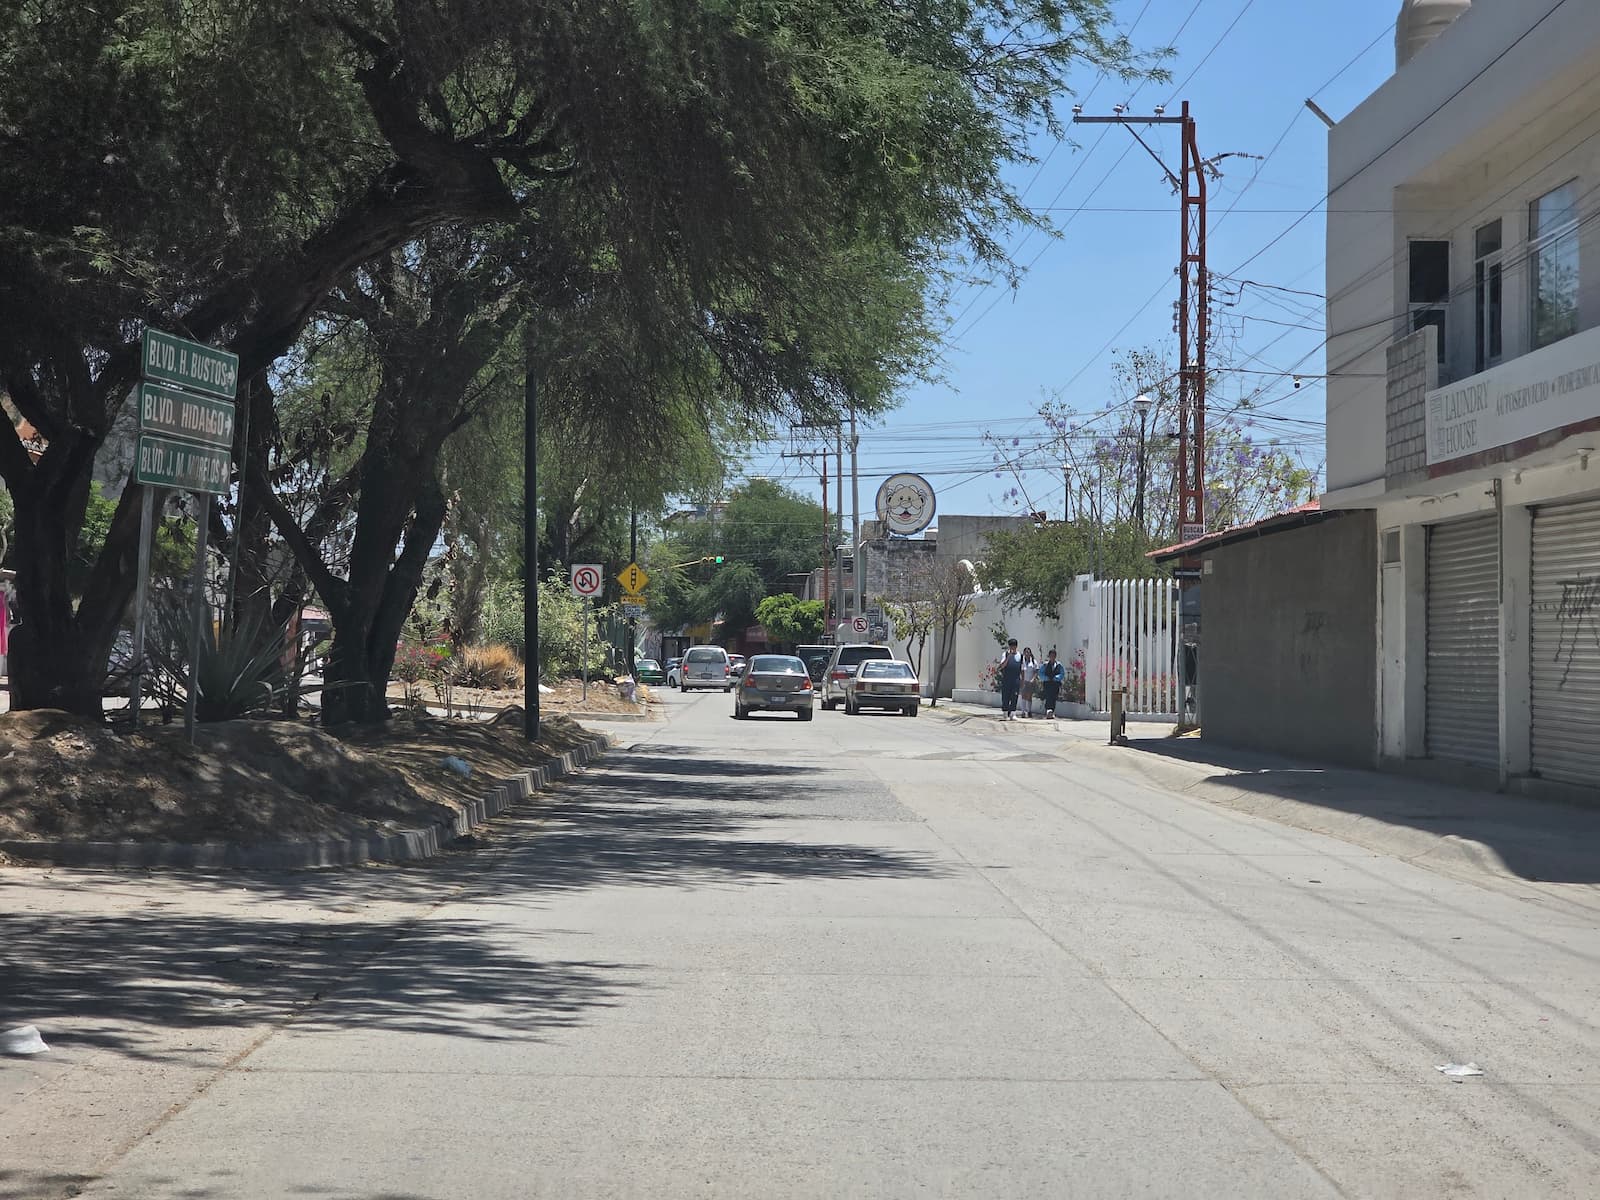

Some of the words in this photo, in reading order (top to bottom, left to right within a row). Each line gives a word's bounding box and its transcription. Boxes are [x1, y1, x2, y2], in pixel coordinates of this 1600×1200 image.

[149, 339, 177, 373] BLVD.
[180, 348, 189, 376] H.
[191, 352, 228, 388] BUSTOS
[144, 393, 176, 425] BLVD.
[181, 402, 225, 436] HIDALGO
[1445, 381, 1489, 421] LAUNDRY
[1495, 380, 1549, 417] AUTOSERVICIO
[1446, 419, 1478, 454] HOUSE
[140, 446, 165, 476] BLVD.
[166, 450, 174, 477] J.
